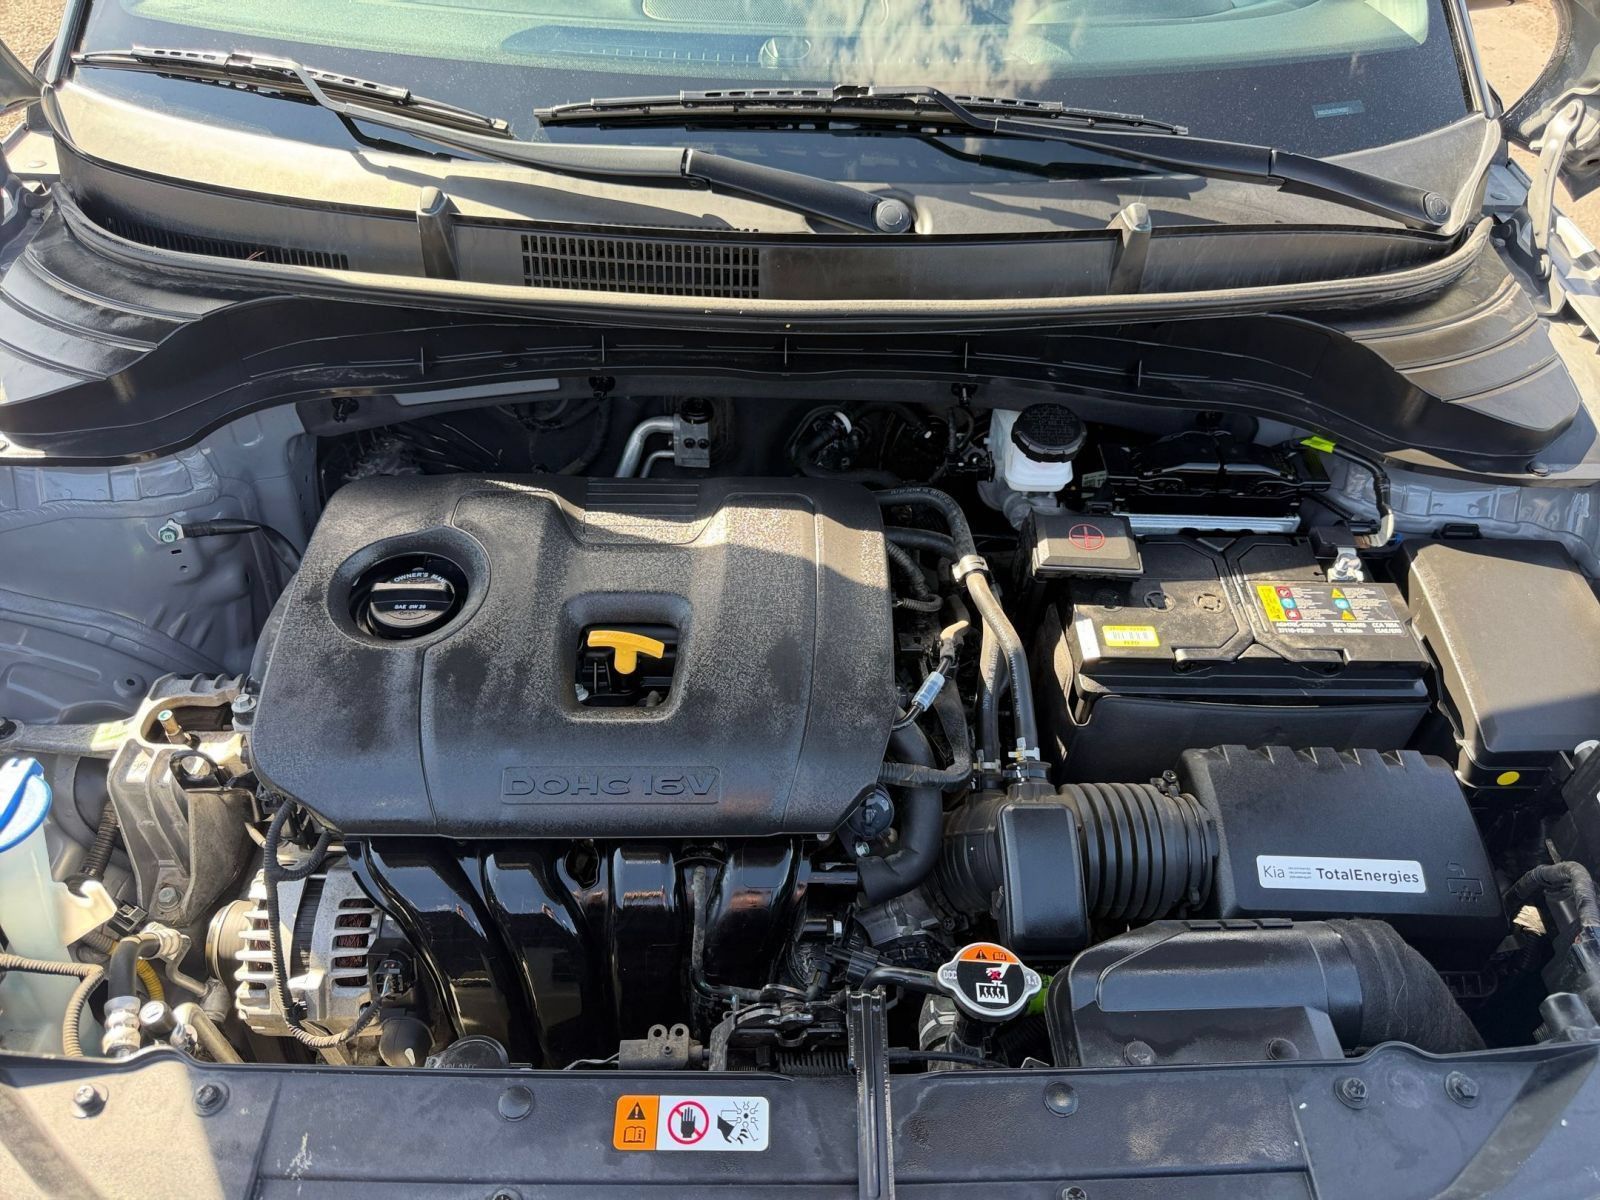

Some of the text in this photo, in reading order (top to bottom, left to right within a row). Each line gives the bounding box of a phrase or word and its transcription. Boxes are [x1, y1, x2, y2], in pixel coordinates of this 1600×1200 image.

[393, 572, 429, 582] OWNER'S
[503, 774, 717, 796] DOHC 16V
[1263, 865, 1420, 885] Kia TotalEnergies
